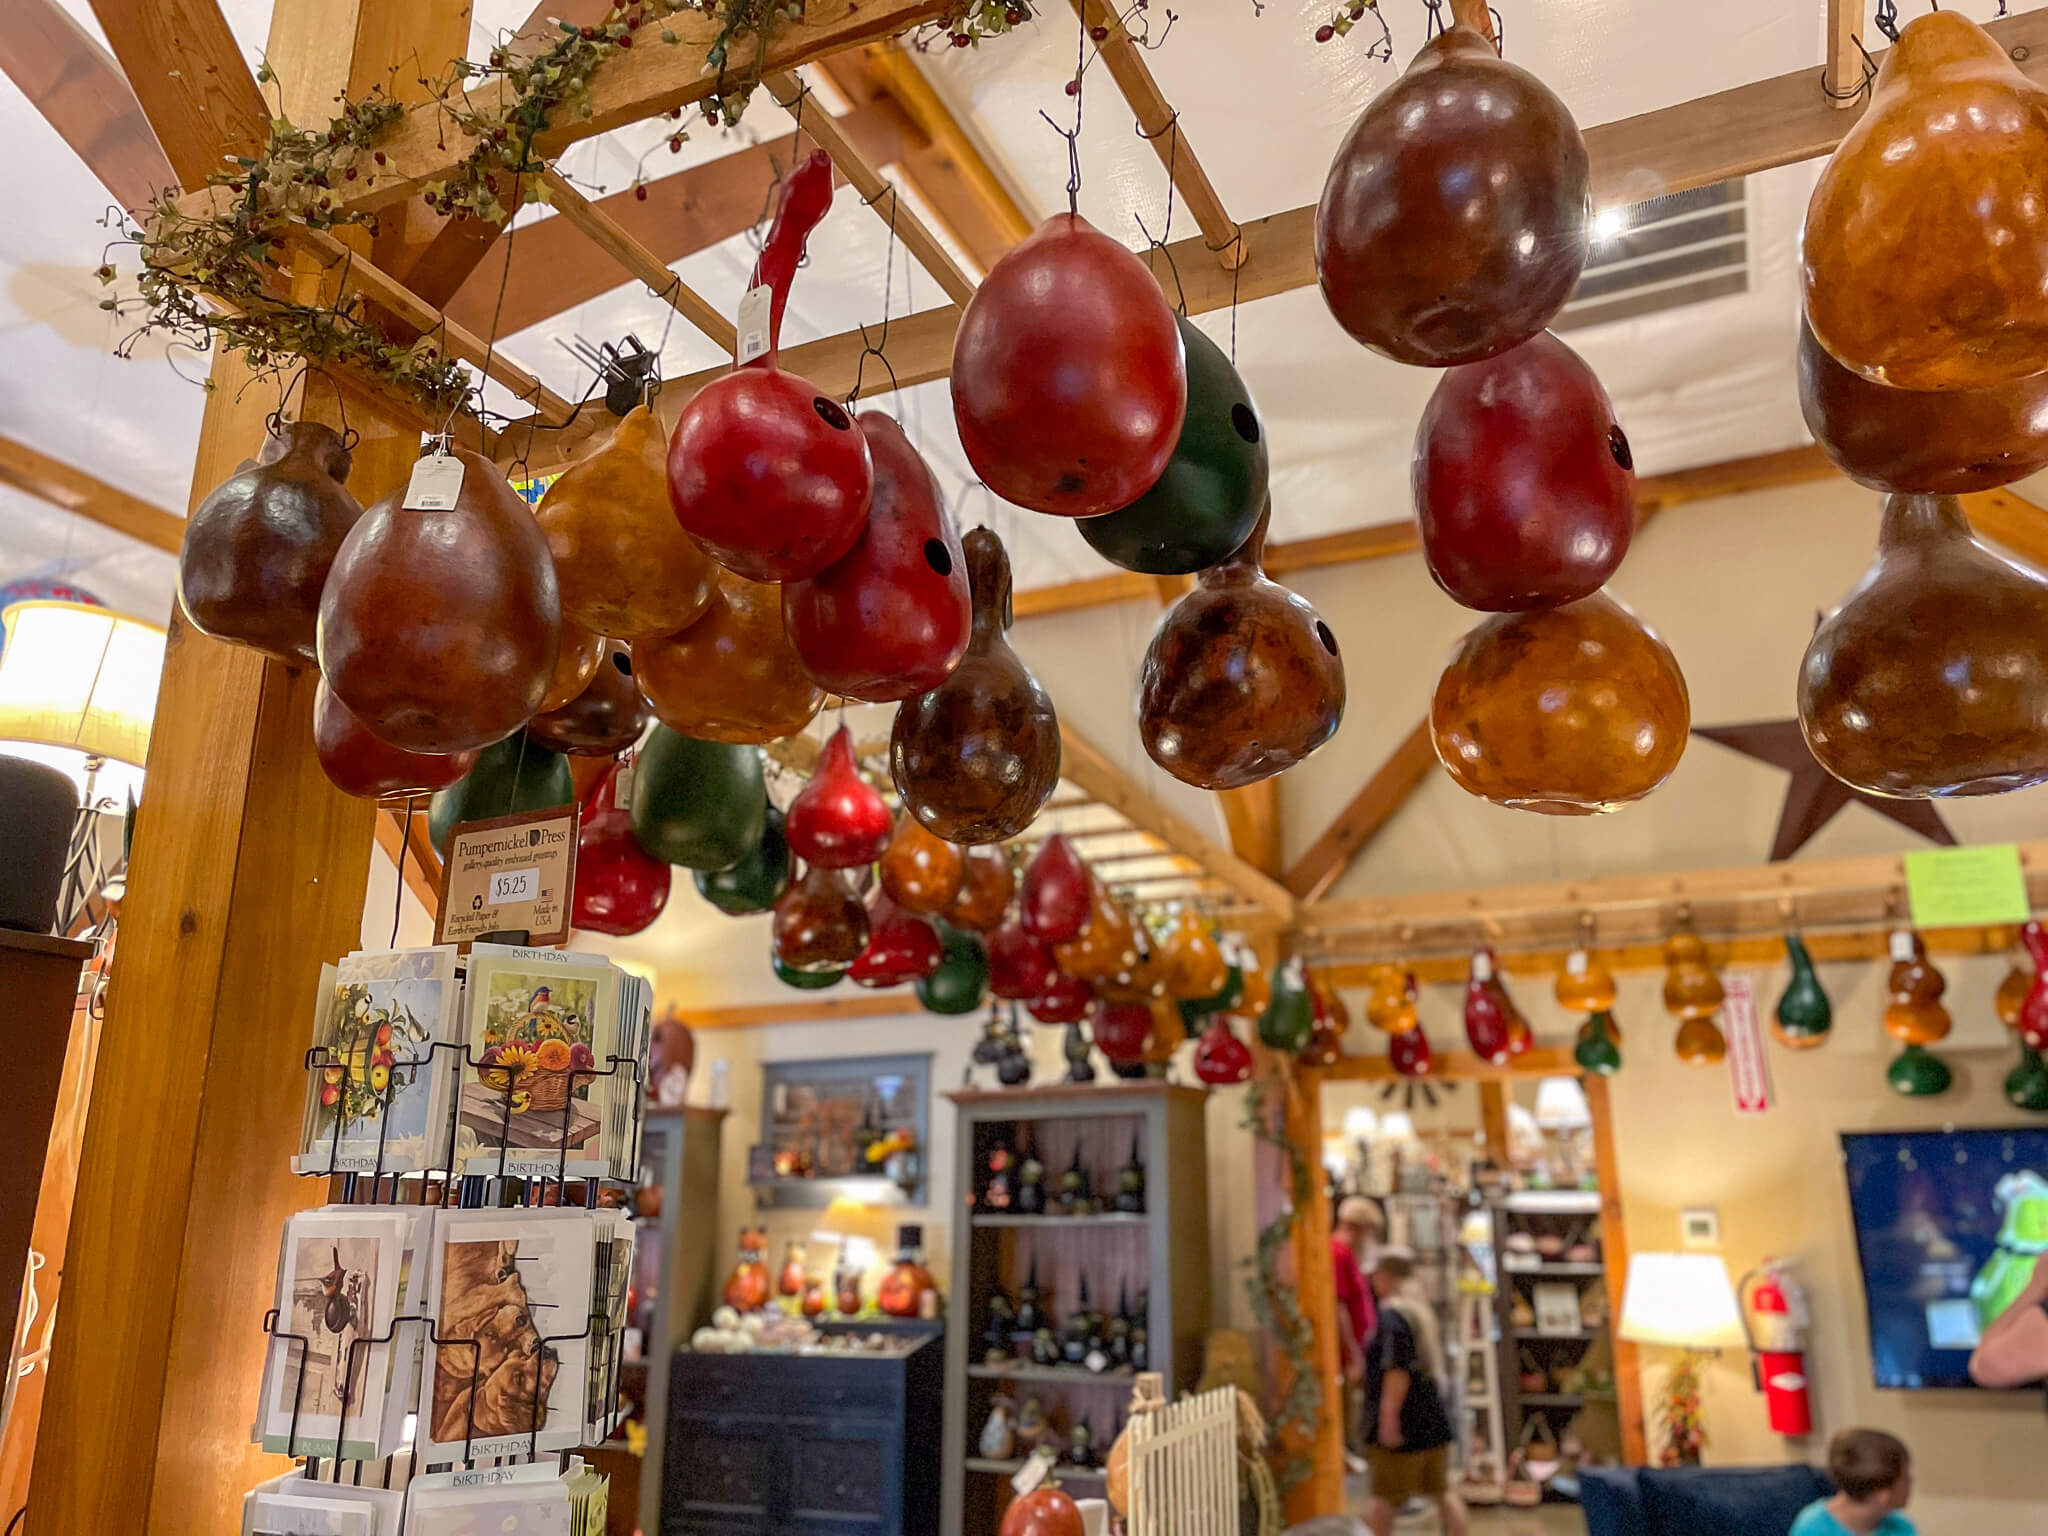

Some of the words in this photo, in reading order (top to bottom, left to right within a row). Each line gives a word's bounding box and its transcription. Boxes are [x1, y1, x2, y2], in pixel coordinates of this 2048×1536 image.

[459, 832, 528, 857] Pumpernickel
[541, 829, 566, 845] Press
[496, 875, 527, 897] $5.25
[512, 949, 568, 962] BIRTHDAY
[508, 1163, 567, 1174] BIRTHDA
[453, 1471, 516, 1487] BIRTHDAY
